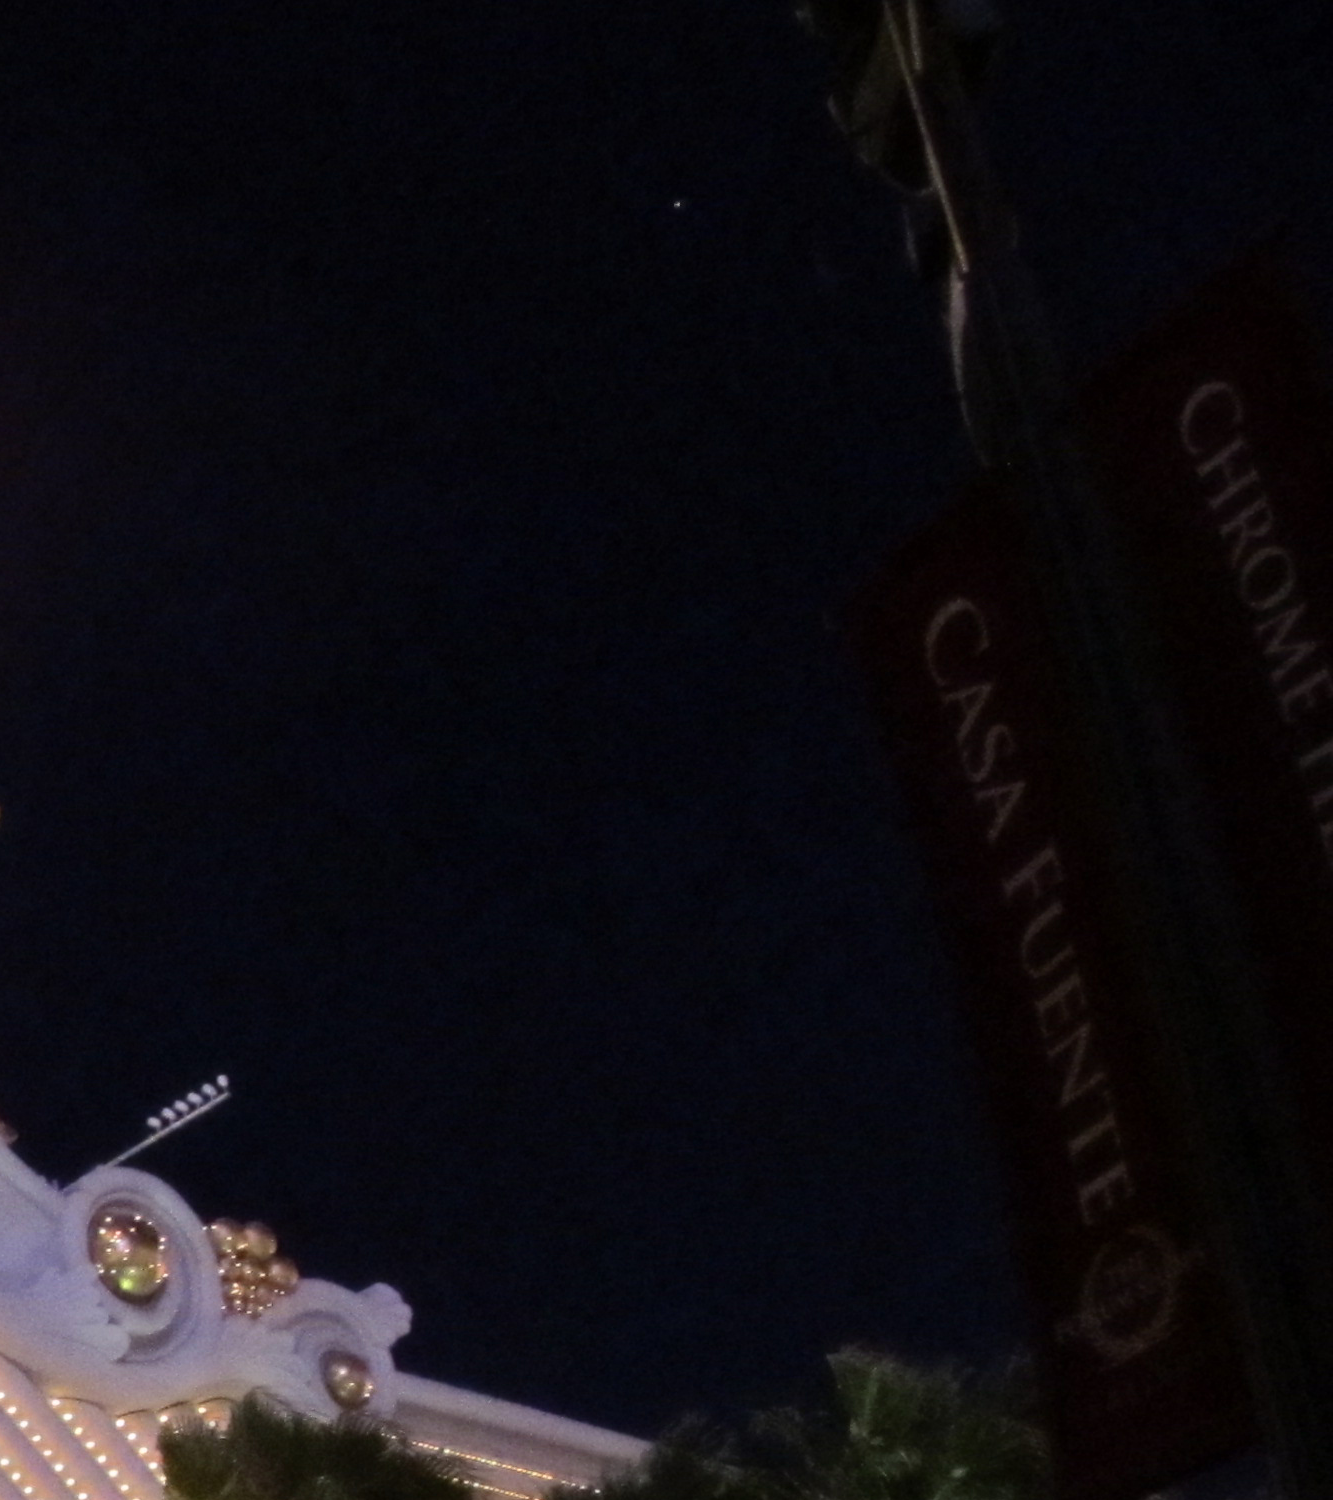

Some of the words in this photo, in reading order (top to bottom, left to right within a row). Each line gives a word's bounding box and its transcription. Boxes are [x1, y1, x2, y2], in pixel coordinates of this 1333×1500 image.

[1180, 379, 1333, 724] CHROME
[925, 598, 1027, 846] CASA
[1001, 843, 1132, 1226] FUENTE
